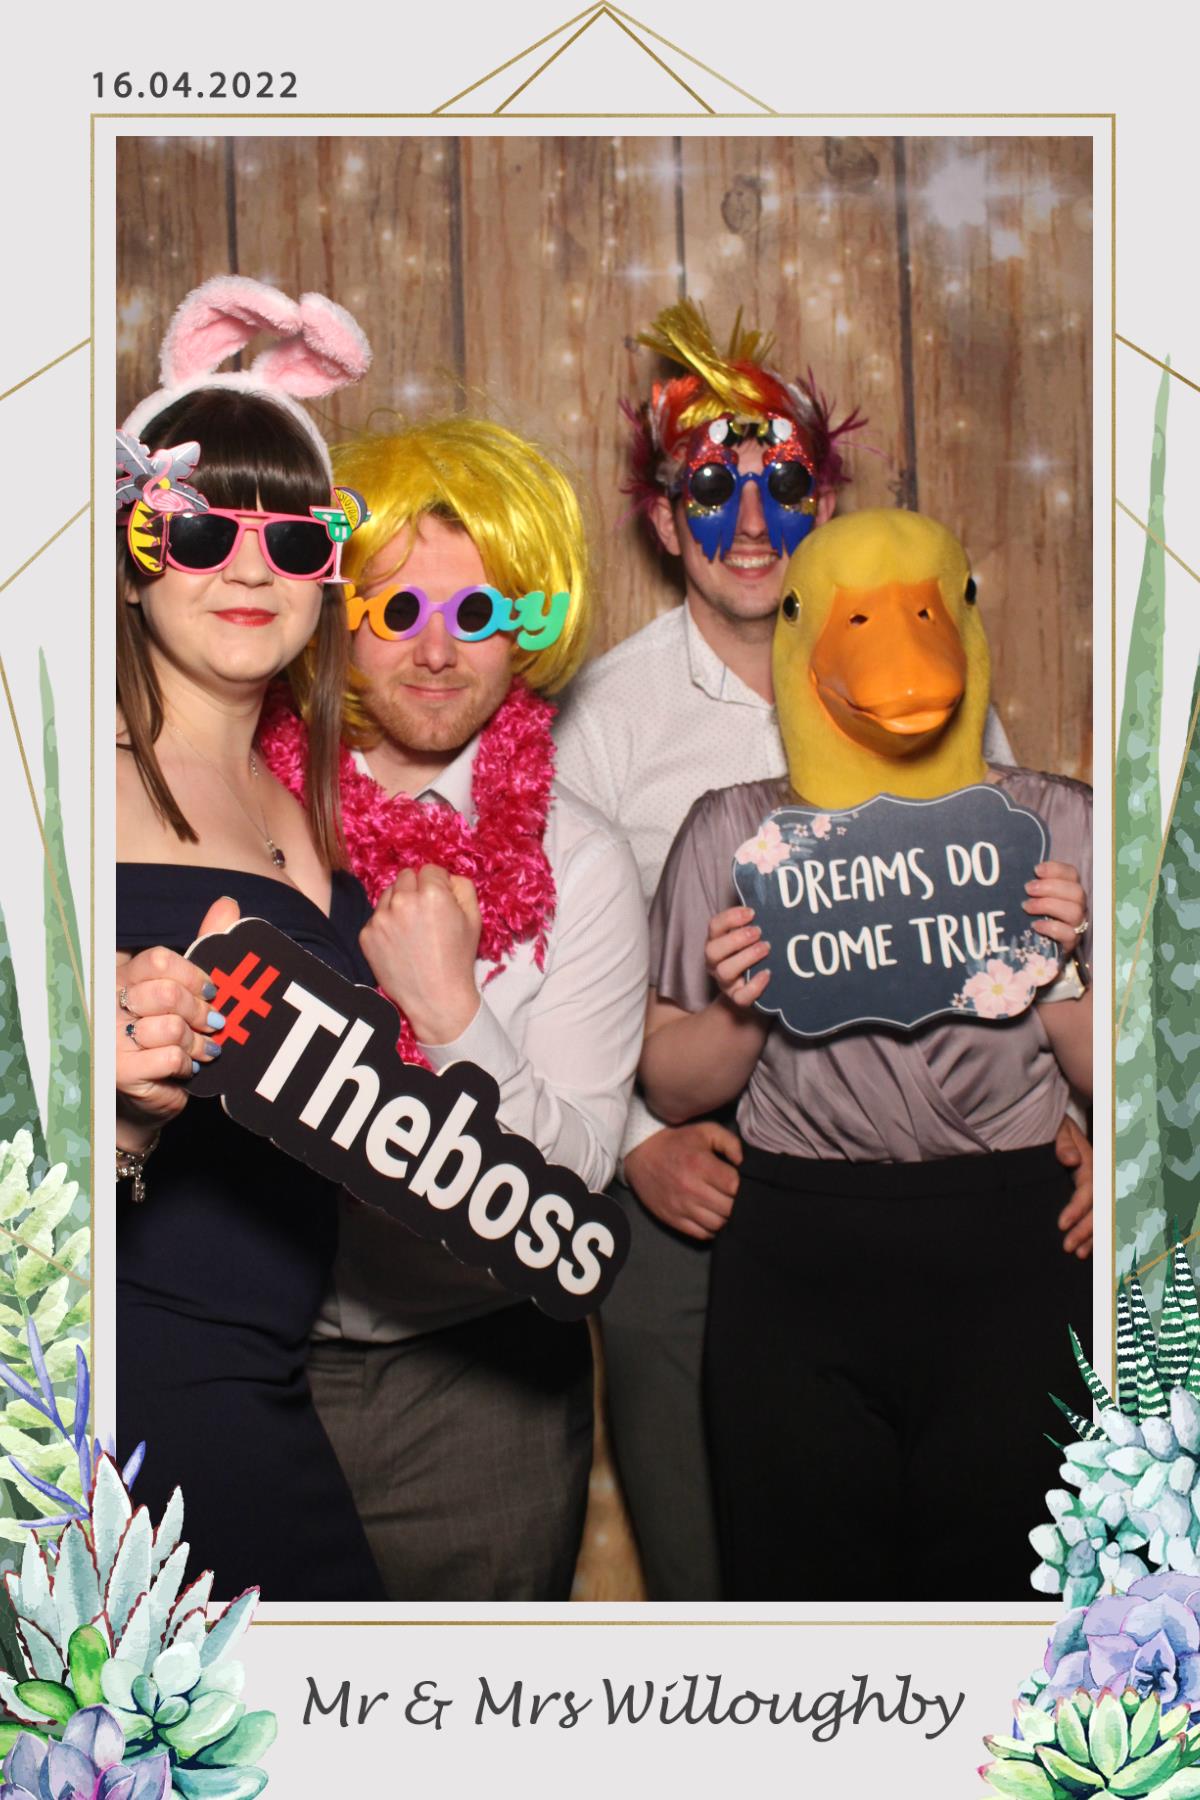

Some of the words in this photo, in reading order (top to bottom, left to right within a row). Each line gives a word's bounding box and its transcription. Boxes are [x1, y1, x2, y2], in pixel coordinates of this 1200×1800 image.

[346, 583, 570, 651] roovy
[777, 848, 934, 913] DREAMS
[946, 842, 999, 886] DO
[787, 924, 897, 978] COME
[909, 911, 1009, 968] TRUE
[209, 951, 615, 1296] #Theboss
